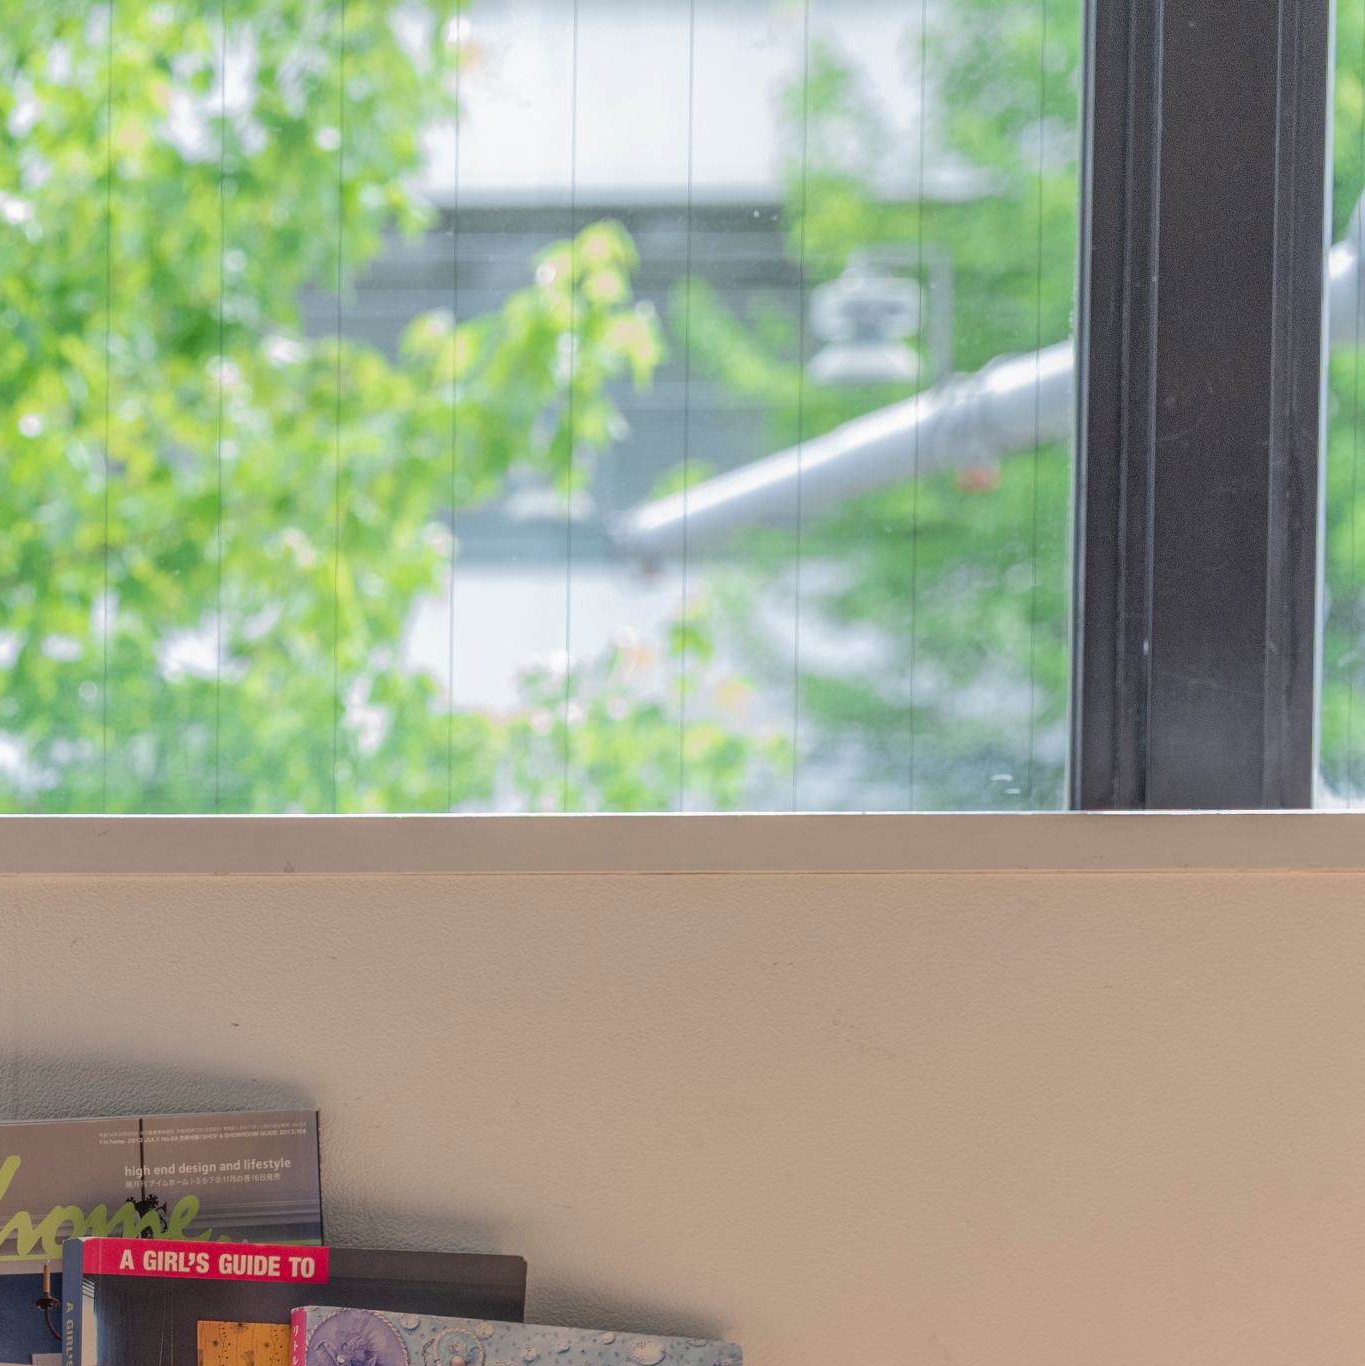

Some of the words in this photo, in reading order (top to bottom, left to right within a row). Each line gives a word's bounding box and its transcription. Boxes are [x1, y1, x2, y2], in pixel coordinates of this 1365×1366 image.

[125, 1164, 151, 1178] high
[153, 1163, 176, 1175] end
[178, 1160, 217, 1174] design
[219, 1158, 241, 1171] and
[243, 1157, 291, 1171] lifestyle
[119, 1248, 135, 1270] A
[142, 1250, 210, 1273] GIRL'S
[218, 1254, 282, 1276] GUIDE
[288, 1256, 316, 1277] TO
[65, 1302, 74, 1313] A
